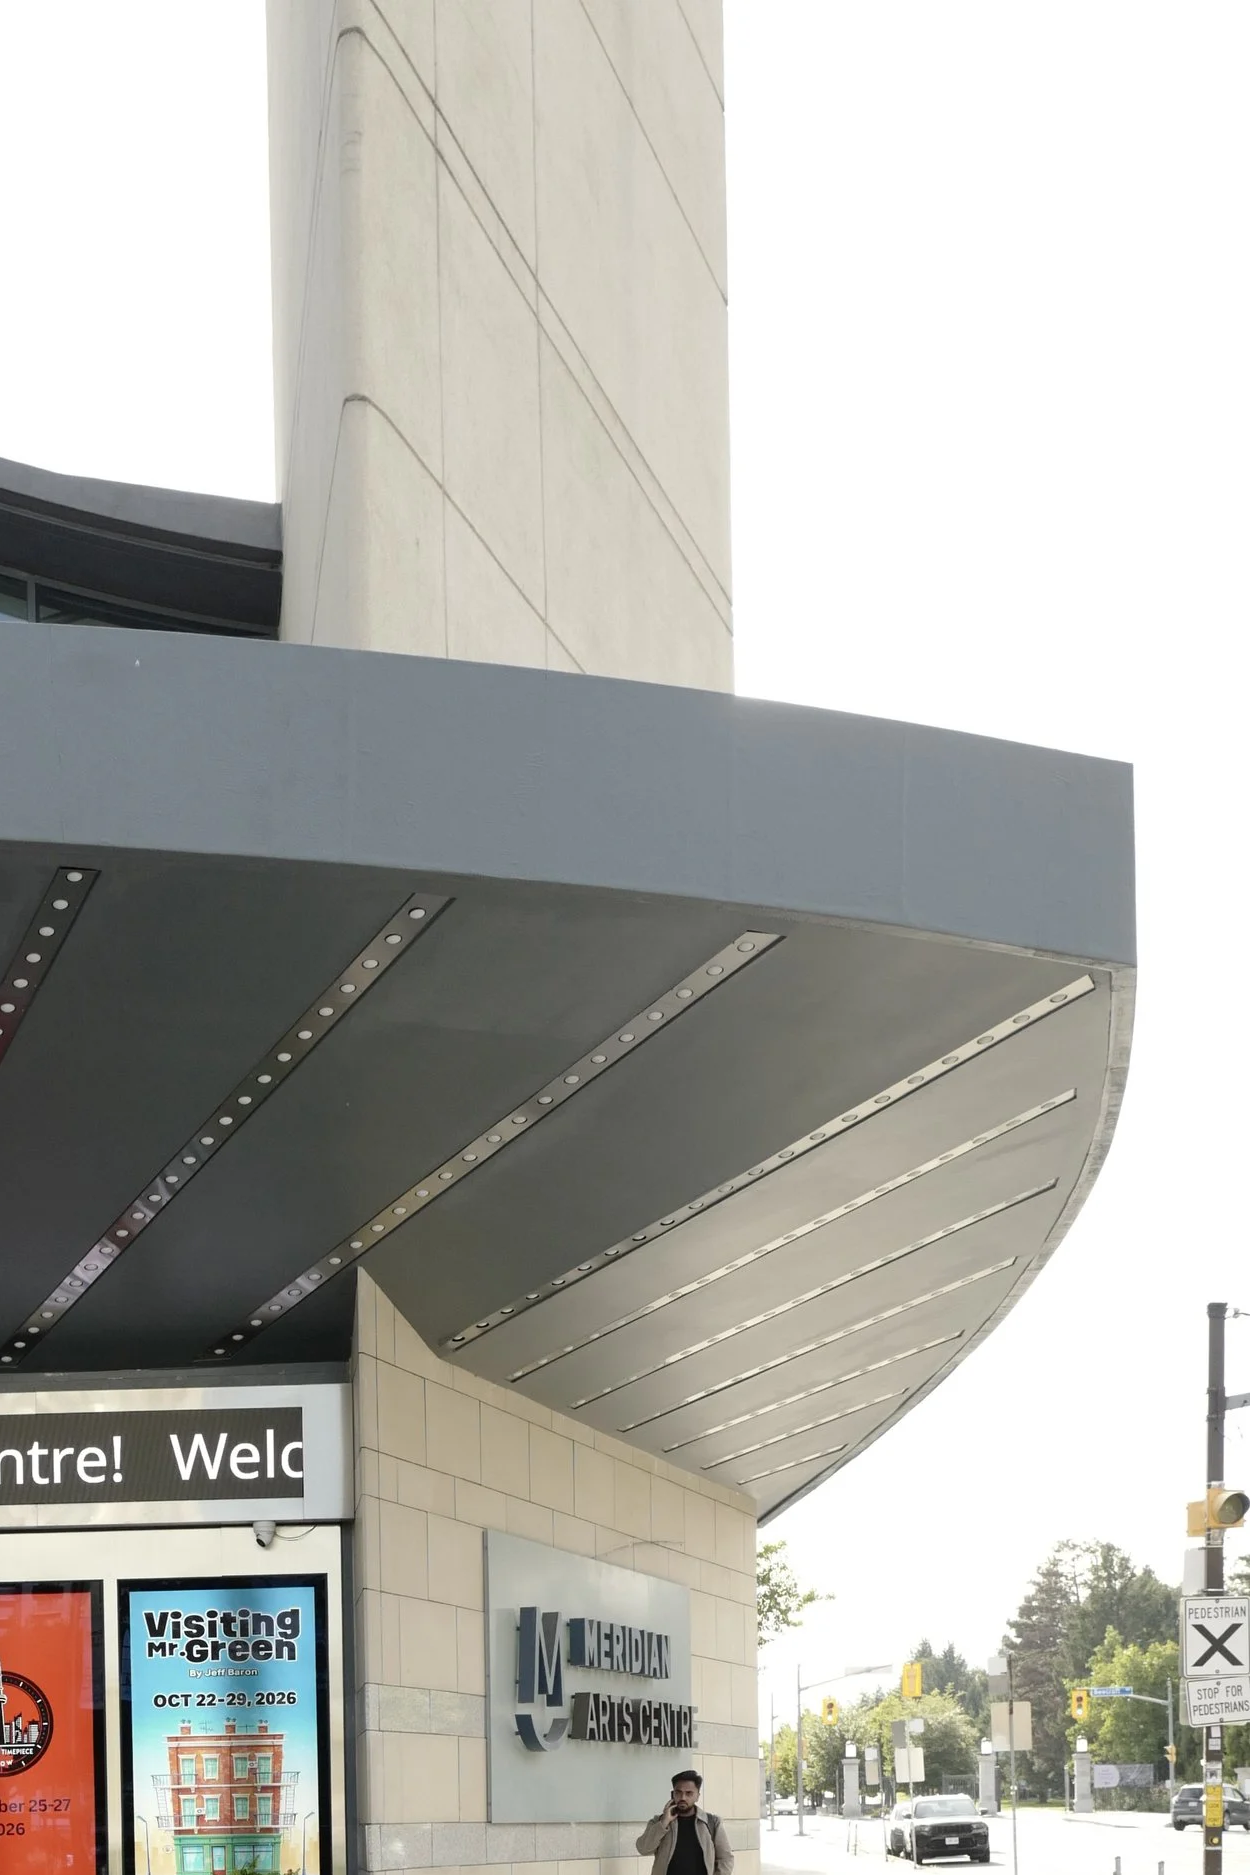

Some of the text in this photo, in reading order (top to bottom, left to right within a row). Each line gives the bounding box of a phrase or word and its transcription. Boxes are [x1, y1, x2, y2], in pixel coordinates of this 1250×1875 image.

[169, 1428, 305, 1481] Welc
[1188, 1606, 1247, 1619] PEDESTRIAN
[143, 1608, 301, 1640] Visiting
[185, 1638, 297, 1663] Green
[570, 1618, 671, 1679] MERIDIAN
[189, 1668, 258, 1679] By Jeff Baron
[153, 1691, 297, 1708] OCT 22-29, 2026
[1197, 1685, 1243, 1700] STOP FOR
[1192, 1700, 1250, 1716] PEDESTRIANS
[572, 1692, 699, 1749] ARTS CENTRE
[29, 1799, 71, 1813] 25-27
